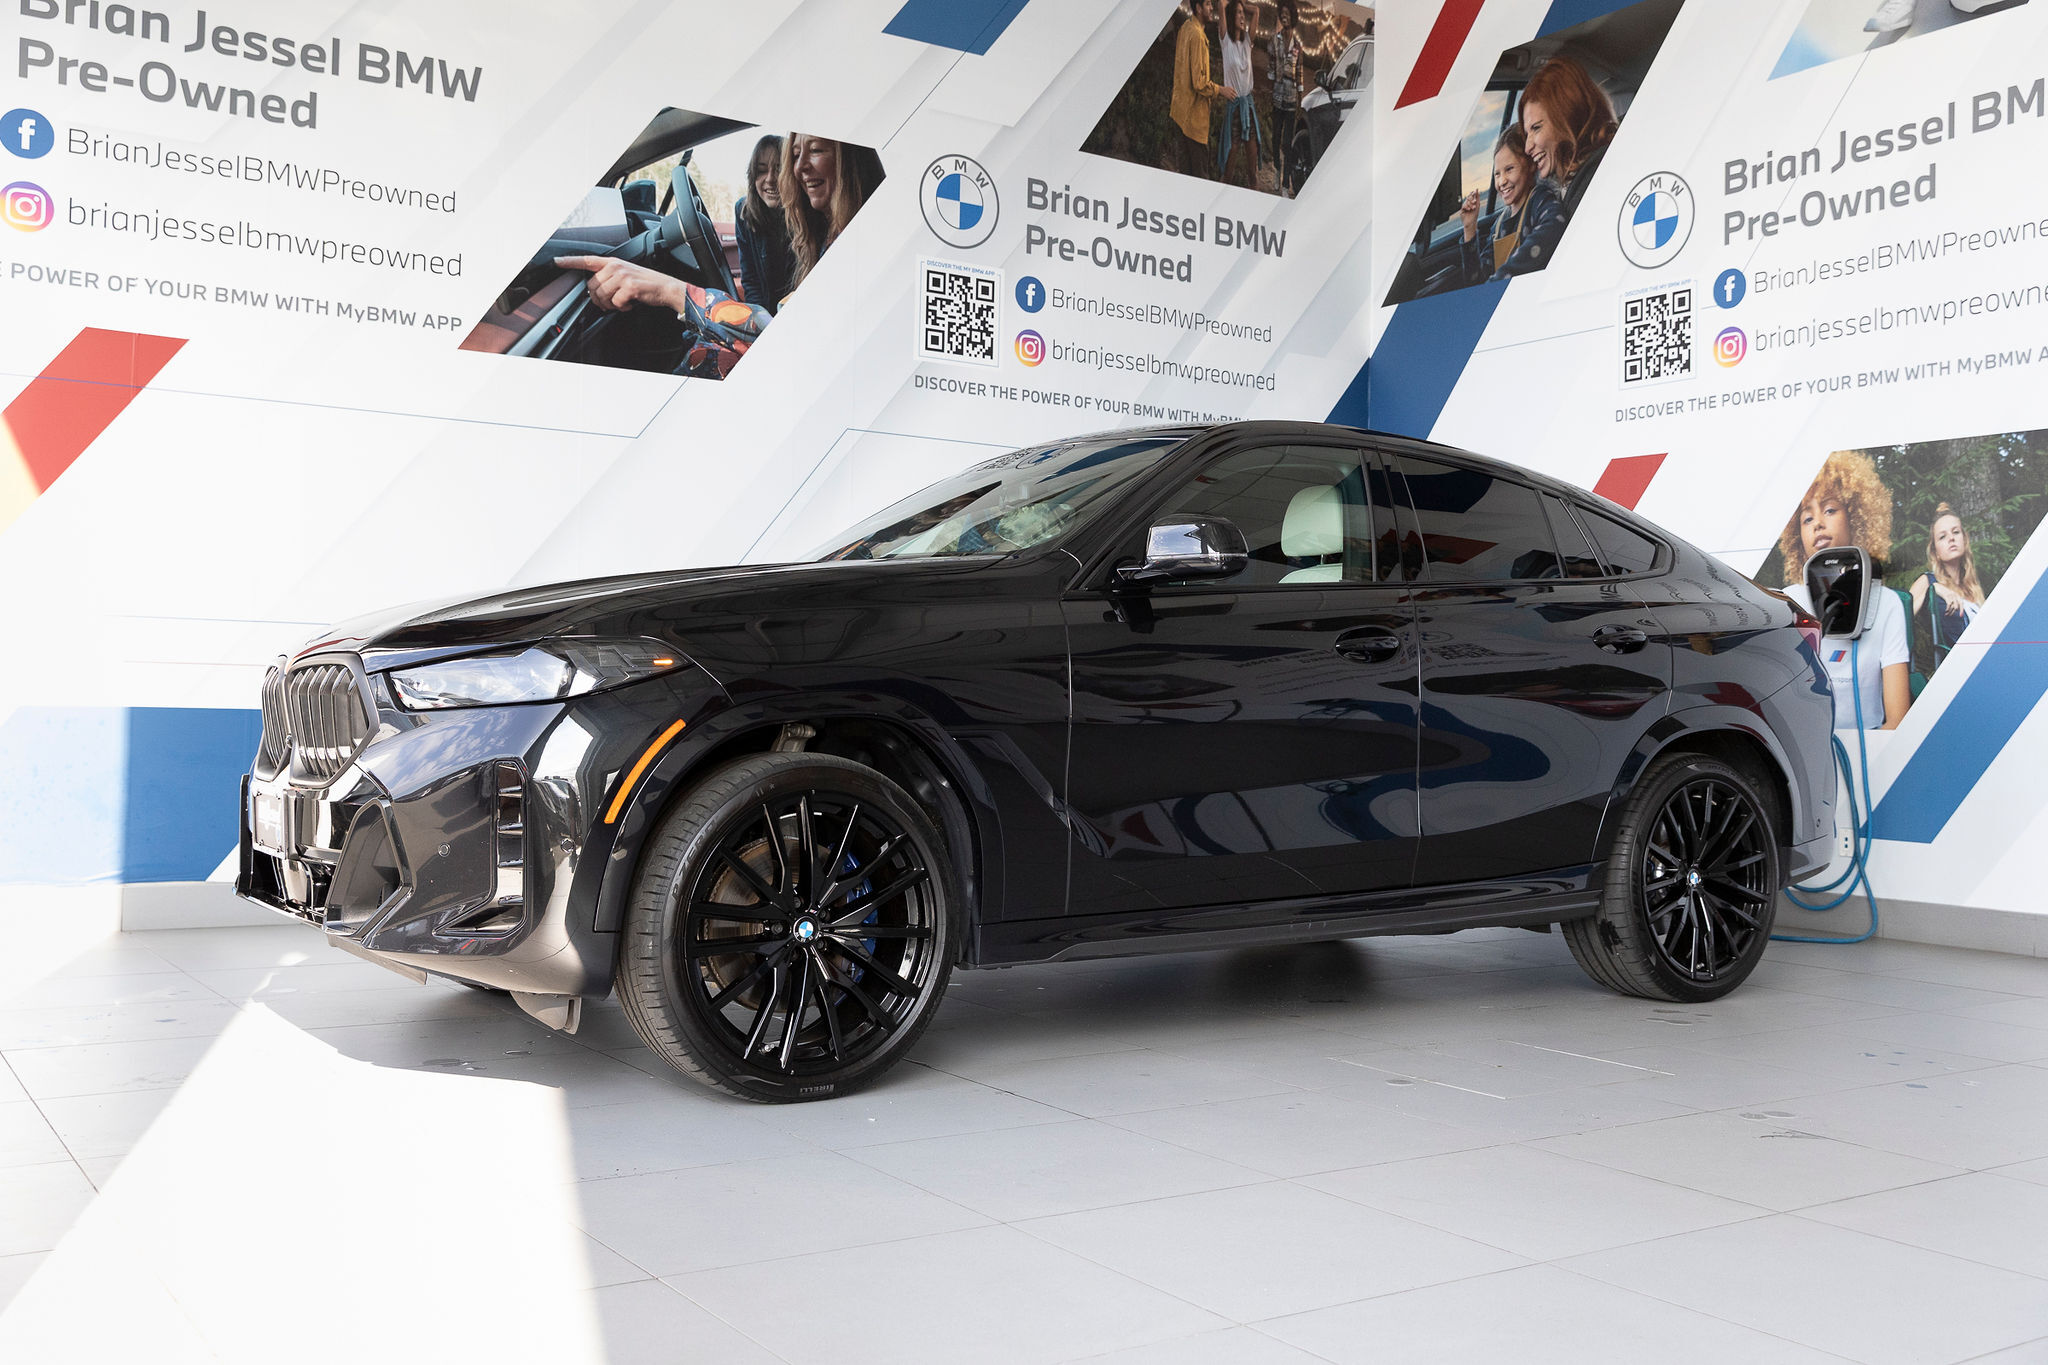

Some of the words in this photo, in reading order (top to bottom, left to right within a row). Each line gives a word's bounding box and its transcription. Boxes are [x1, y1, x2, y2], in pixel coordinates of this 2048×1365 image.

[19, 37, 317, 129] Pre-Owned
[184, 10, 340, 76] Jessel
[358, 43, 483, 102] BMW
[69, 128, 456, 213] BrianJesselBMWPreowned
[931, 159, 990, 188] BMW
[1724, 150, 1820, 196] Brian
[1831, 102, 1955, 174] Jessel
[1027, 177, 1109, 223] Brian
[1117, 197, 1205, 242] Jessel
[1215, 216, 1287, 258] BMW
[1628, 177, 1685, 208] BMW
[1724, 163, 1937, 246] Pre-Owned
[69, 197, 462, 276] brianjesselbmwpreowned
[1026, 224, 1192, 283] Pre-Owned
[11, 262, 99, 289] POWER
[108, 275, 138, 293] OF
[145, 278, 206, 301] YOUR
[216, 287, 268, 307] BMW
[275, 294, 328, 315] WITH
[337, 302, 416, 327] MyBMW
[422, 314, 462, 332] APP
[1053, 288, 1272, 343] BrianJesselBMWPreowned
[1756, 285, 2048, 351] brianjesselbmwpreown
[915, 375, 986, 397] DISCOVER
[990, 385, 1018, 400] THE
[1022, 389, 1070, 407] POWER
[1075, 396, 1092, 409] OF
[1095, 398, 1130, 414] YOUR
[1134, 404, 1165, 419] BMW
[1168, 408, 1199, 422] WITH
[1053, 339, 1276, 392] brianjesselbmwpreowned
[1616, 401, 1684, 422] DISCOVER
[1688, 395, 1716, 411] THE
[1722, 387, 1777, 407] POWER
[1782, 381, 1802, 398] OF
[1806, 376, 1851, 395] YOUR
[1858, 368, 1899, 388] BMW
[1905, 361, 1950, 381] WITH
[1958, 348, 2032, 374] MyBMW
